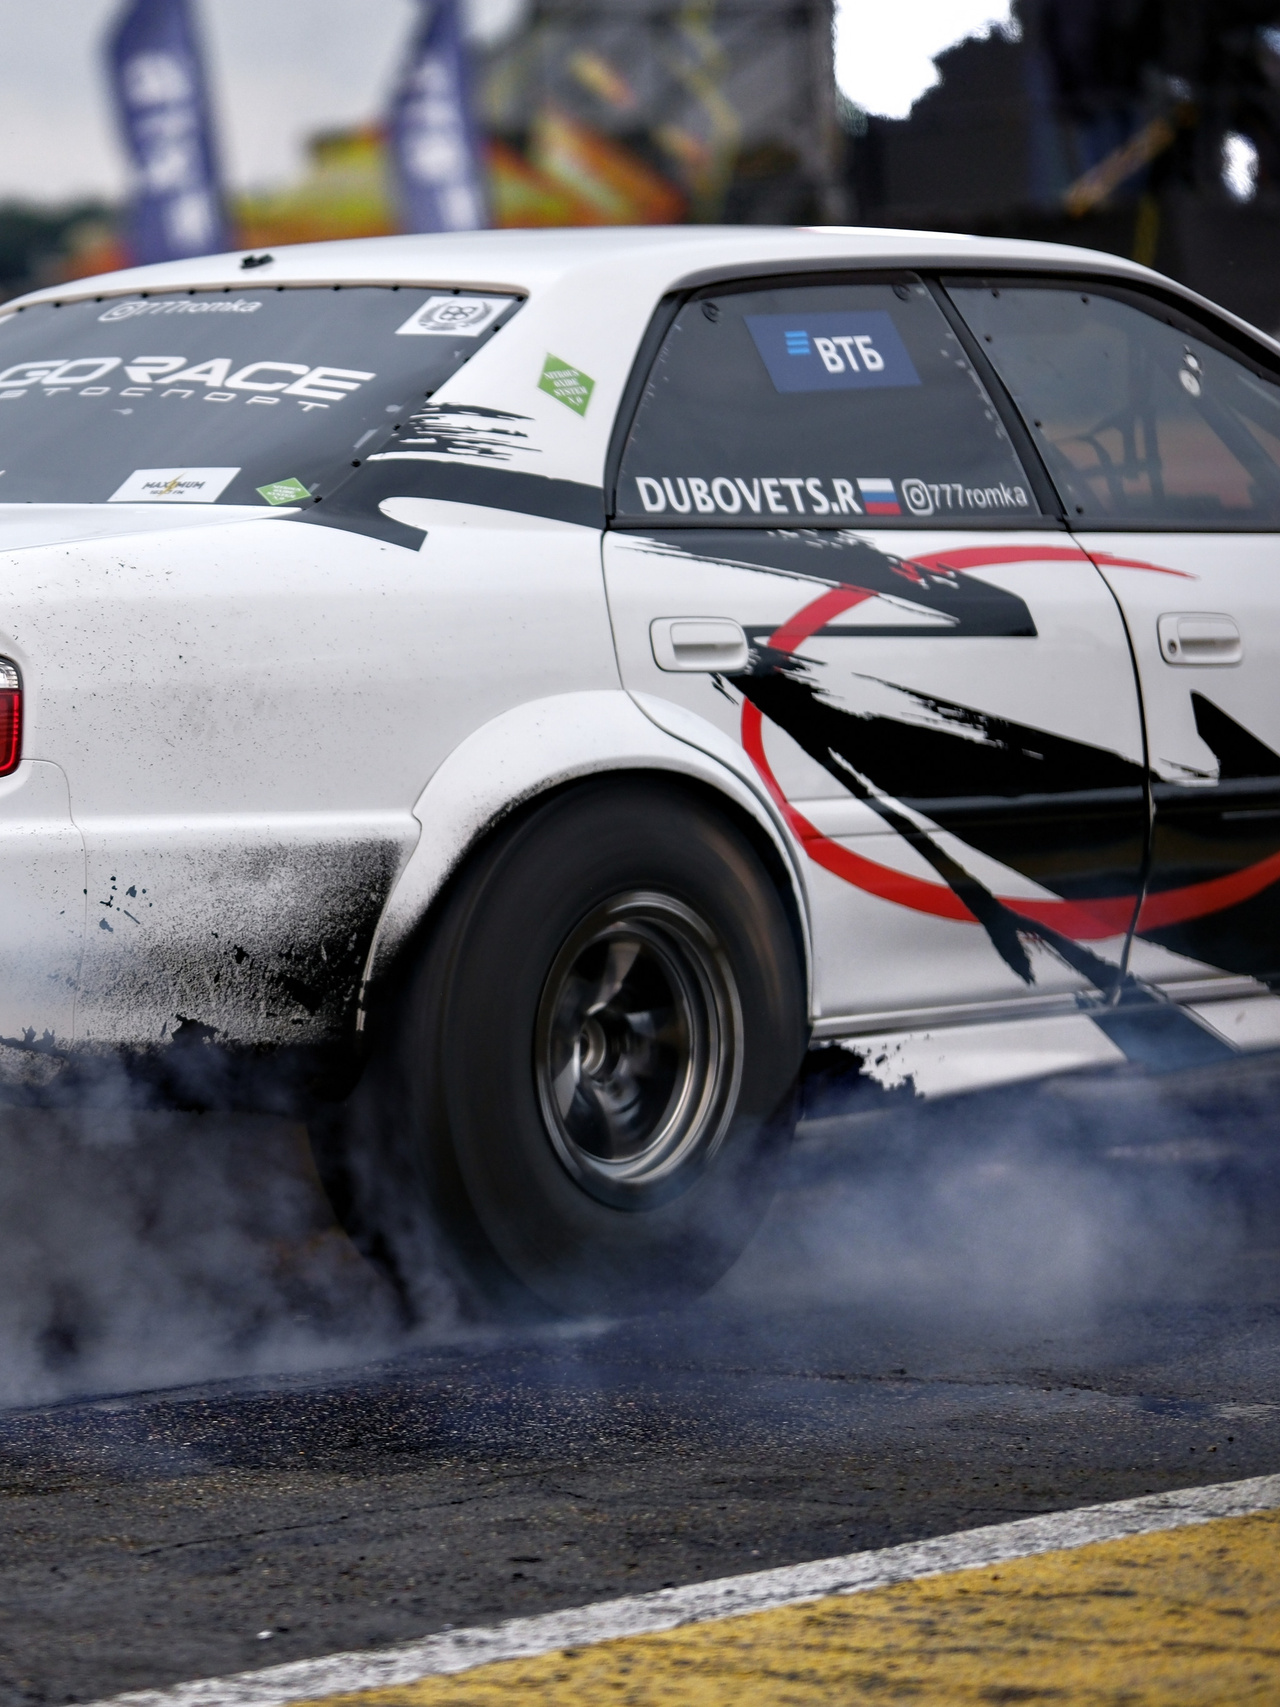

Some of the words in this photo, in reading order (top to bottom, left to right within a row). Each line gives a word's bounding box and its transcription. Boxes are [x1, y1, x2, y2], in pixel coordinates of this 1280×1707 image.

[813, 335, 885, 373] ВТБ
[636, 477, 863, 514] DUBOVETS.R
[929, 482, 1028, 508] 777romka
